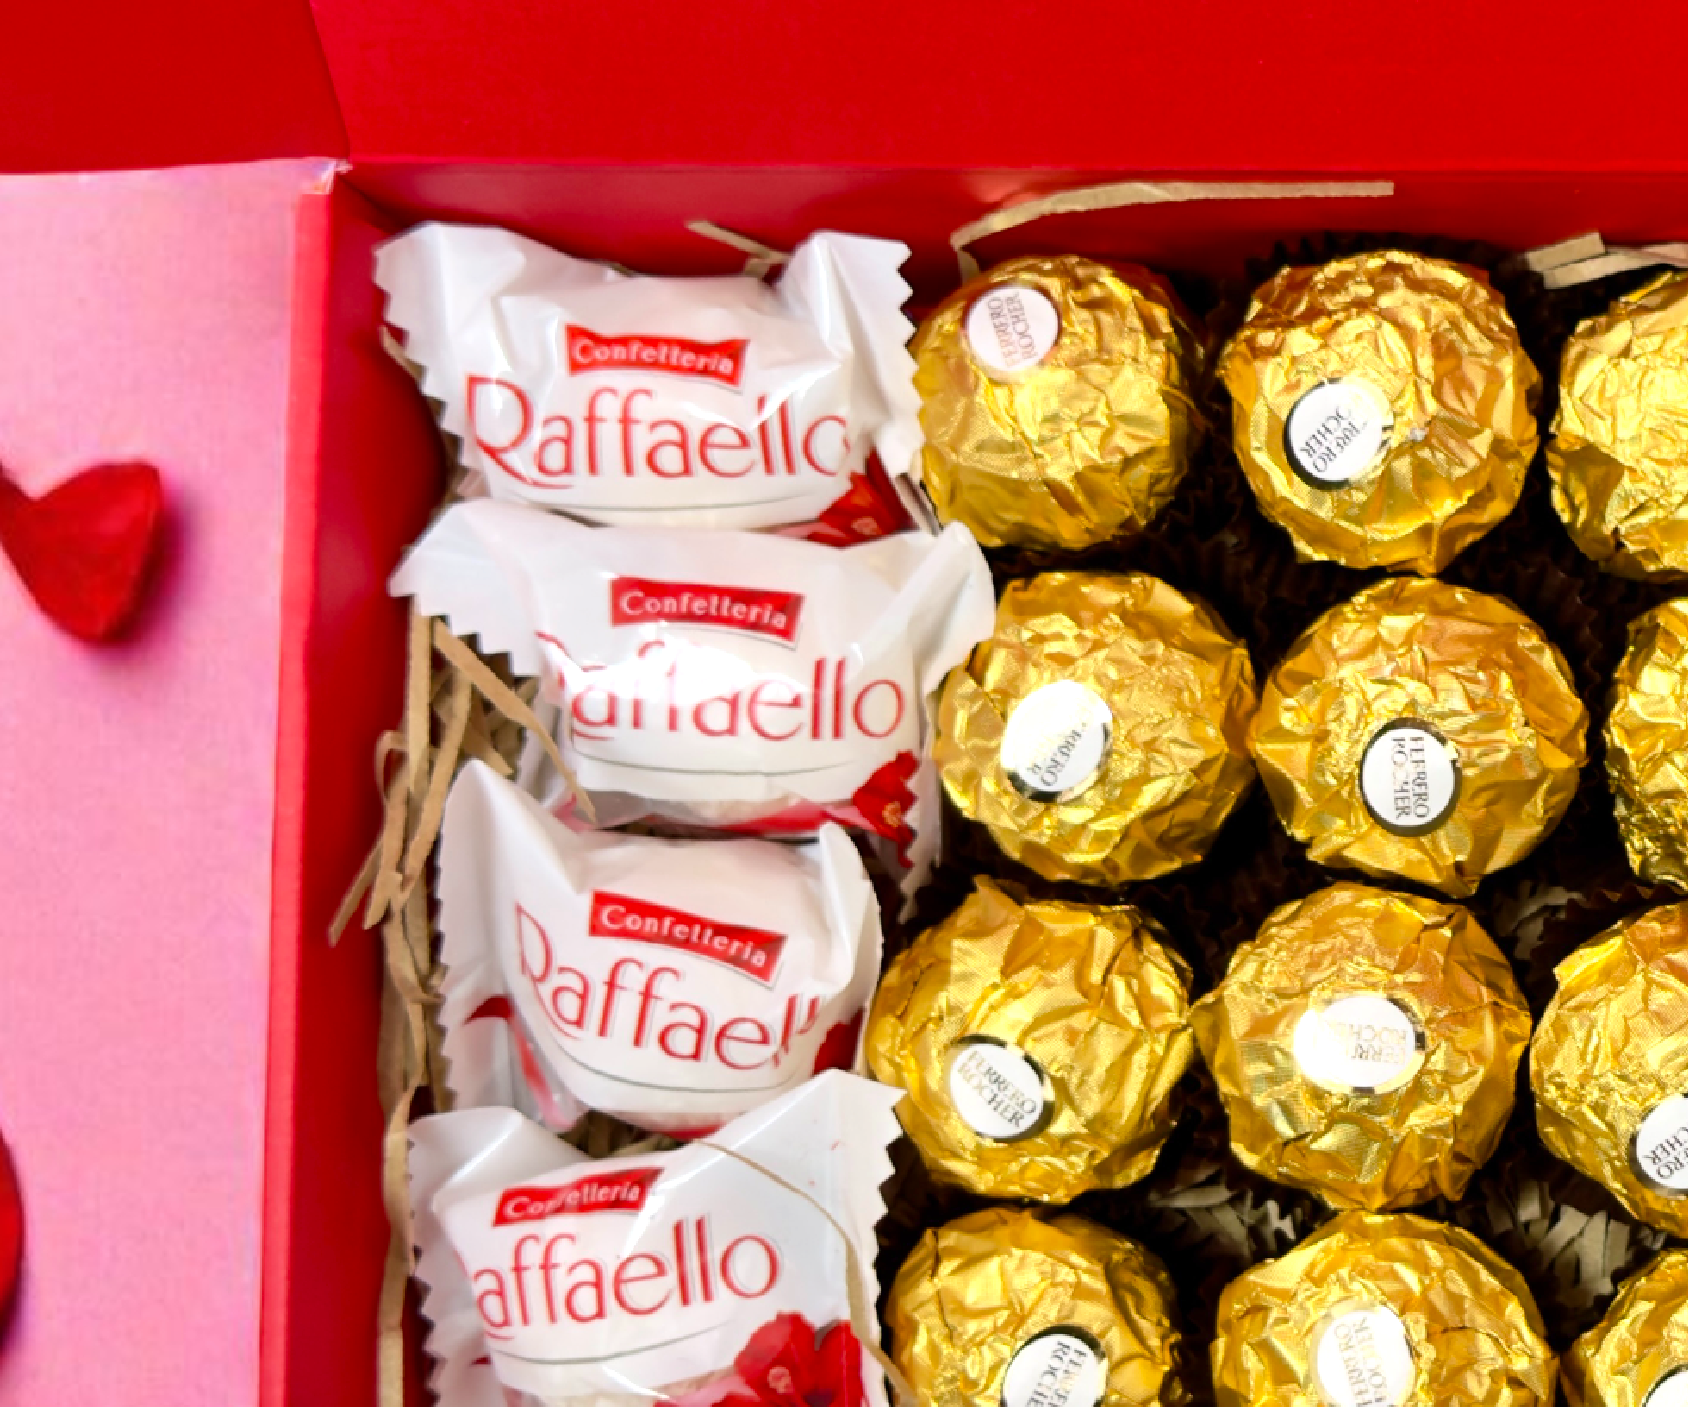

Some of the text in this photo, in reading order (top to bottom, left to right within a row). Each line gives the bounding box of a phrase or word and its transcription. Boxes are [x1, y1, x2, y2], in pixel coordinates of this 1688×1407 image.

[575, 338, 735, 377] Confetteria
[465, 374, 851, 489] Raffaello
[618, 589, 788, 630] Confetteria
[601, 903, 769, 969] Confetteria
[455, 1214, 782, 1341] affaello
